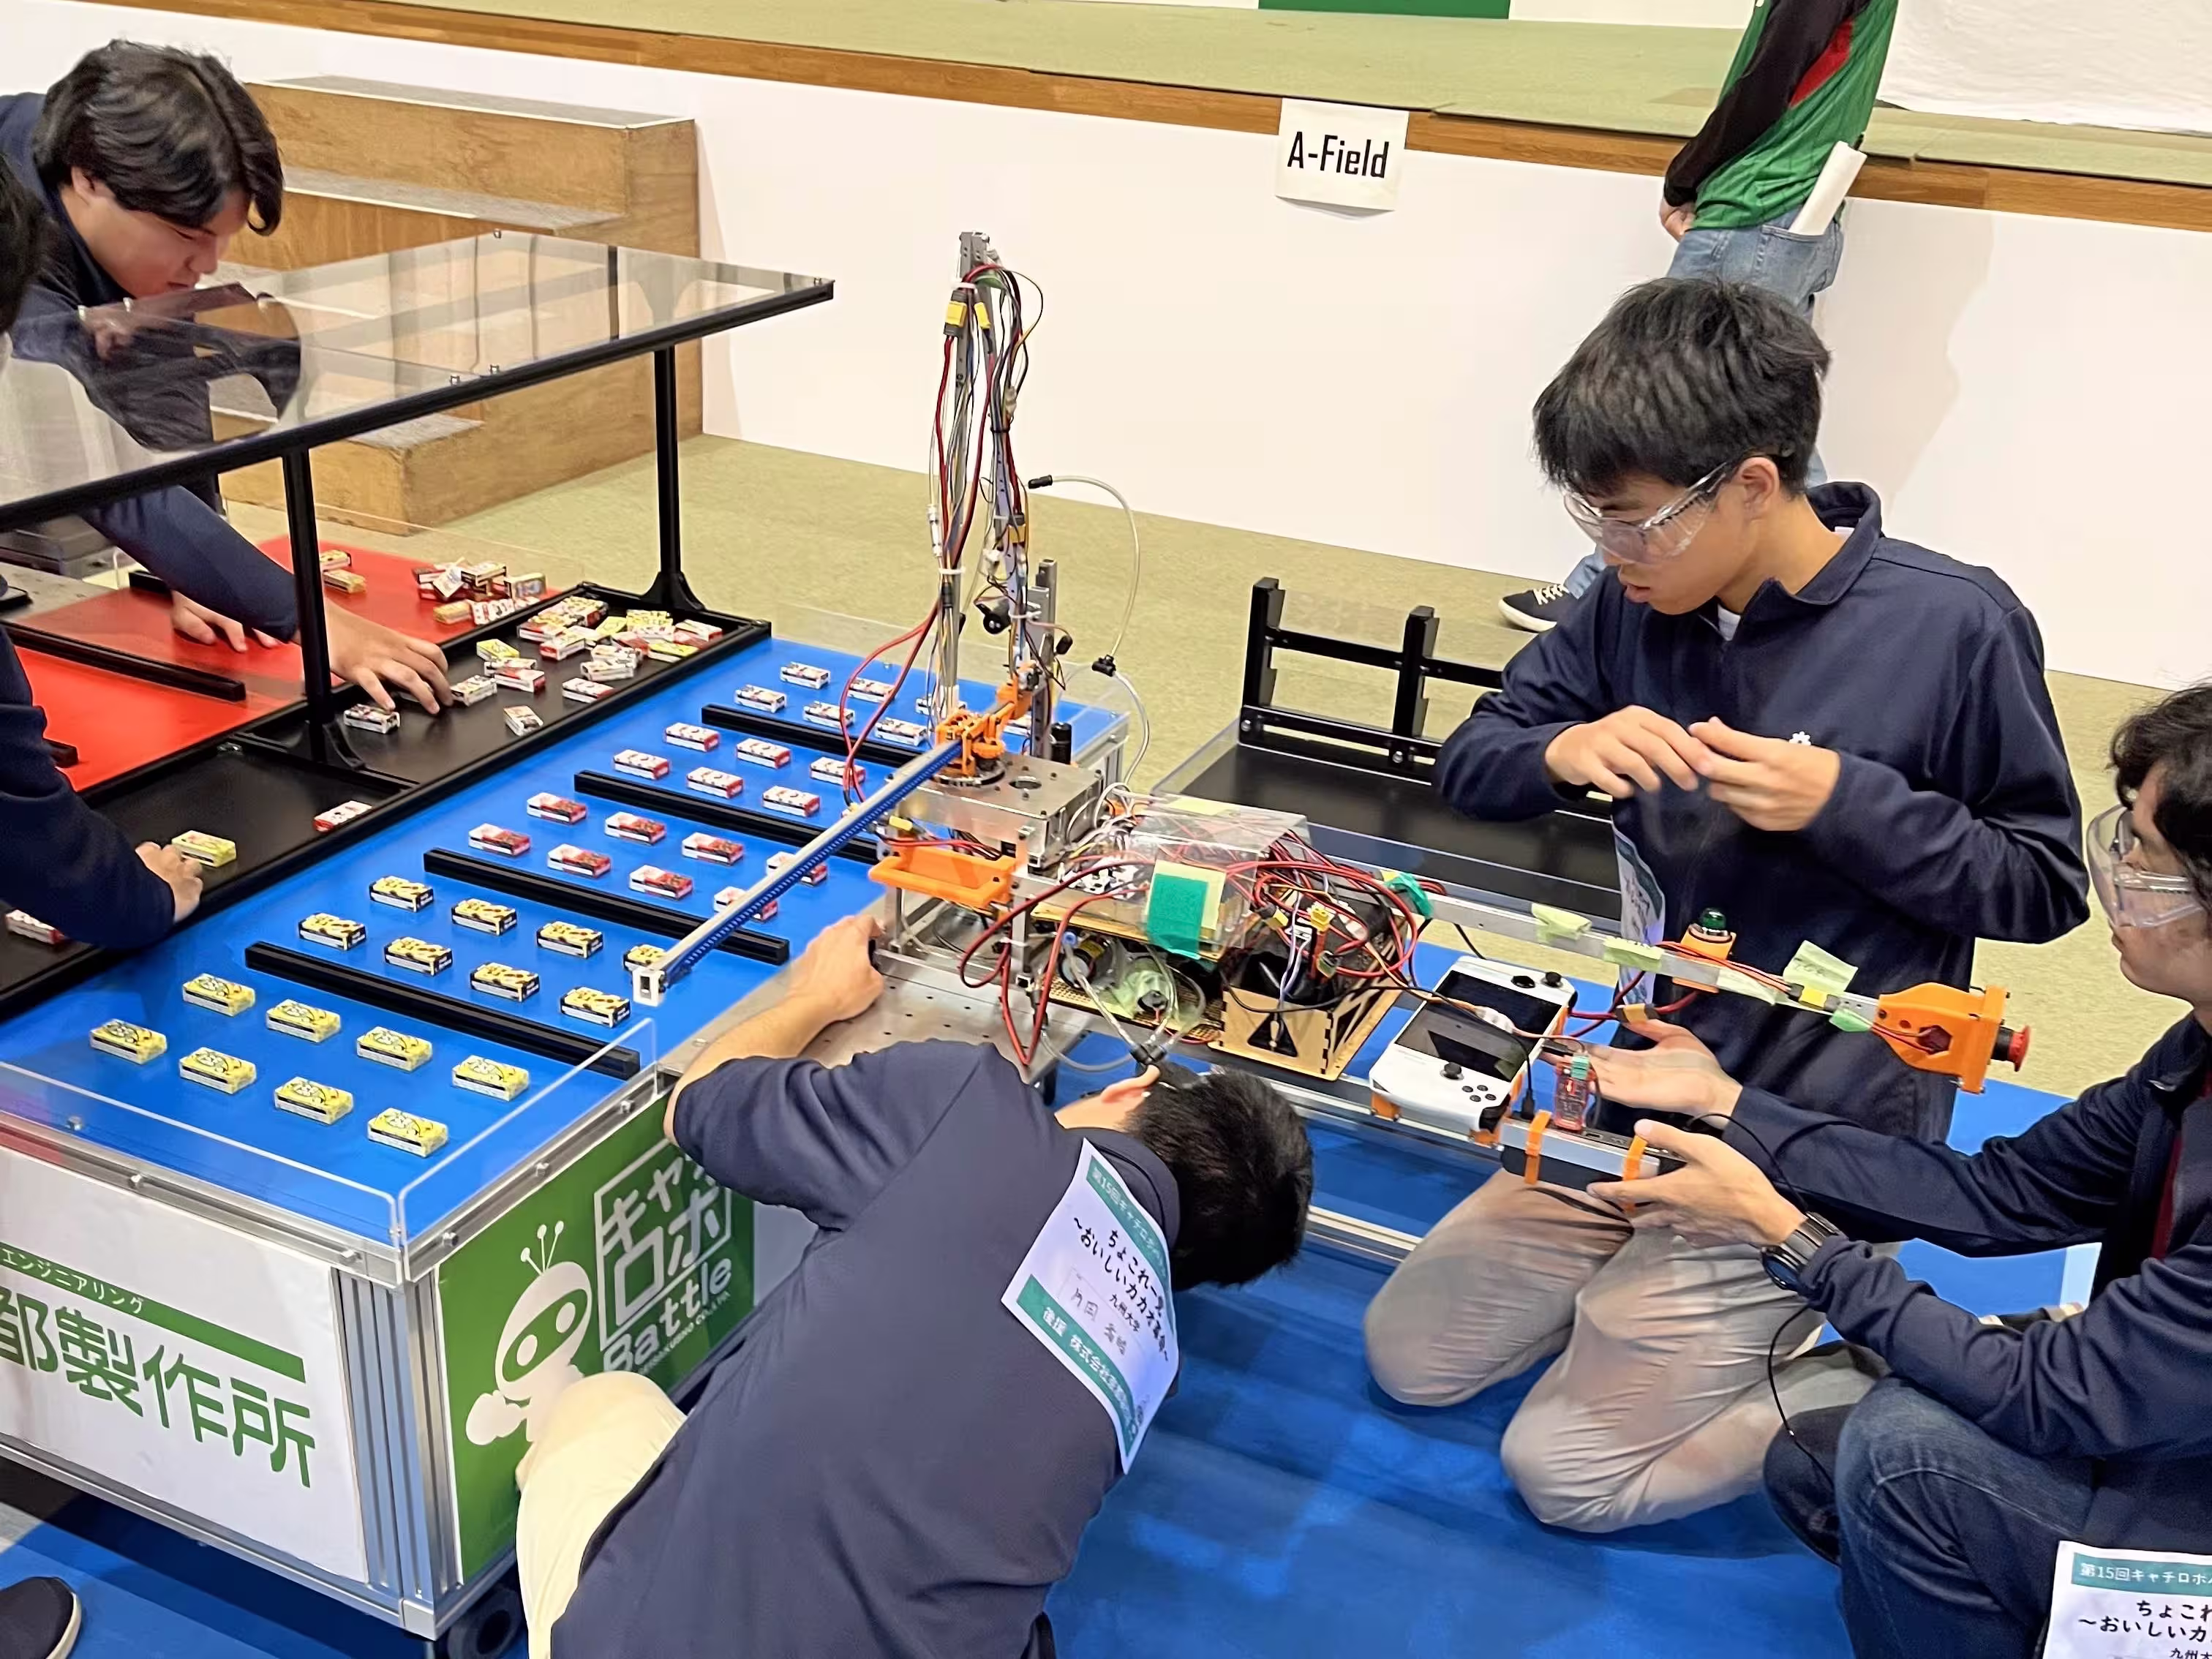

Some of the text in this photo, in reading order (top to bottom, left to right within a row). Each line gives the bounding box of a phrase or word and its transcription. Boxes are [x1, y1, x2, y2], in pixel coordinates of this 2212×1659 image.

[1287, 131, 1390, 178] A-Field
[1, 1247, 144, 1314] エンジニアリング
[603, 1258, 731, 1372] Battle
[0, 1285, 315, 1488] 都製作所
